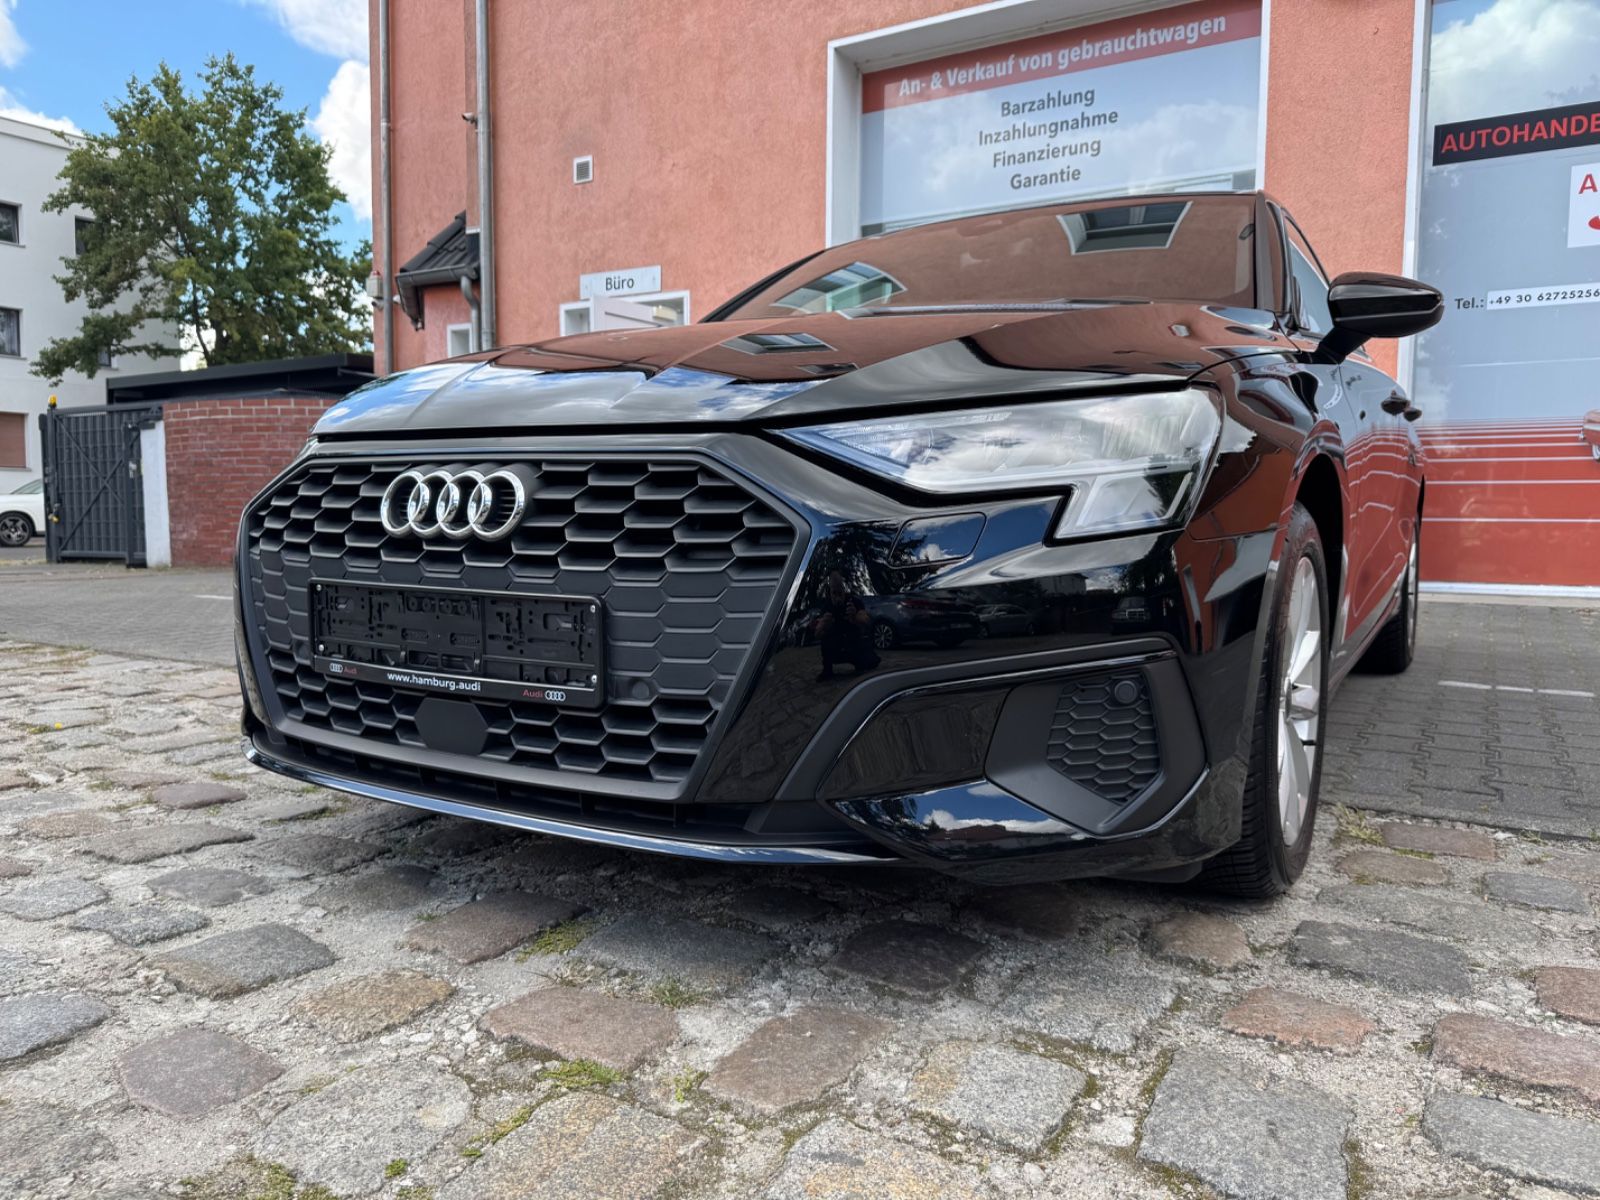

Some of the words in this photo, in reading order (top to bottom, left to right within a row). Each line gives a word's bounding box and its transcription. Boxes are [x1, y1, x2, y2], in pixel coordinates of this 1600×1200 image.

[899, 78, 926, 97] An-
[930, 71, 943, 90] &
[946, 54, 1016, 87] Verkauf
[1019, 52, 1053, 71] von
[1057, 16, 1226, 69] gebrauchtwagen
[1001, 89, 1095, 117] Barzahlung
[979, 111, 1119, 146] Inzahlungnahme
[1441, 112, 1600, 153] AUTOHANDE
[993, 140, 1101, 168] Finanzierung
[1010, 165, 1081, 190] Garantie
[605, 276, 634, 291] Büro
[1454, 298, 1484, 310] Tel.:
[1516, 294, 1532, 303] 30
[344, 667, 357, 675] Audi
[387, 672, 481, 691] www.hamburg.audi
[523, 689, 543, 698] Audi
